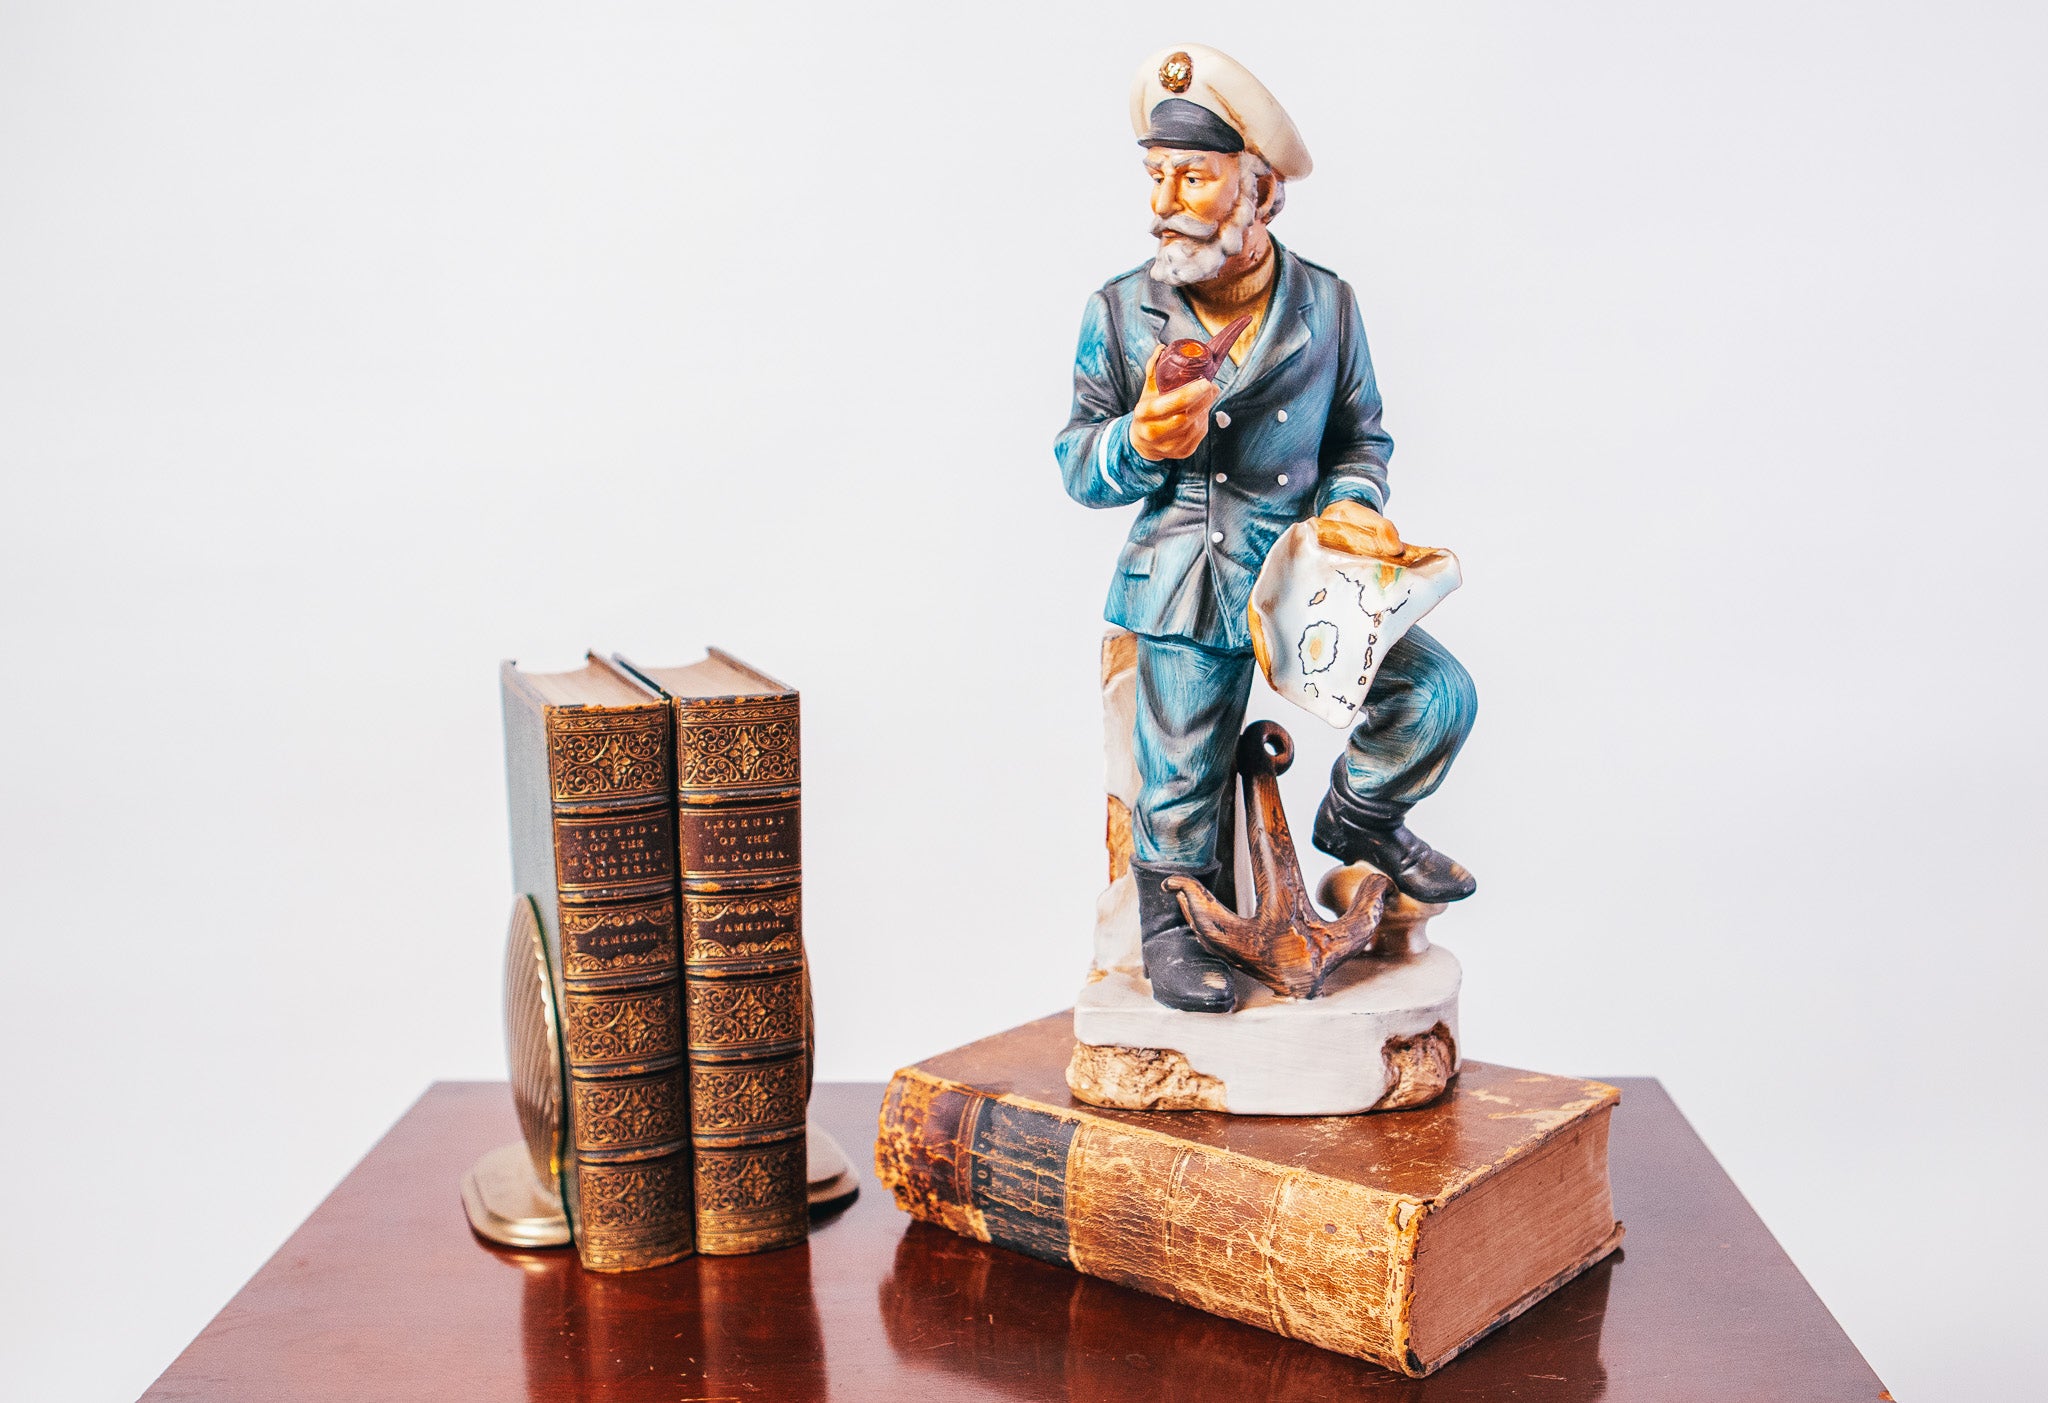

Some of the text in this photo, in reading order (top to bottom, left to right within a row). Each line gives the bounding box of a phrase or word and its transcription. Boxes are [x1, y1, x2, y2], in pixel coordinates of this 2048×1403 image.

[703, 816, 784, 830] LEGENDS
[589, 839, 644, 852] OF THE
[720, 834, 770, 846] OF THE
[567, 850, 662, 867] MONASTIC
